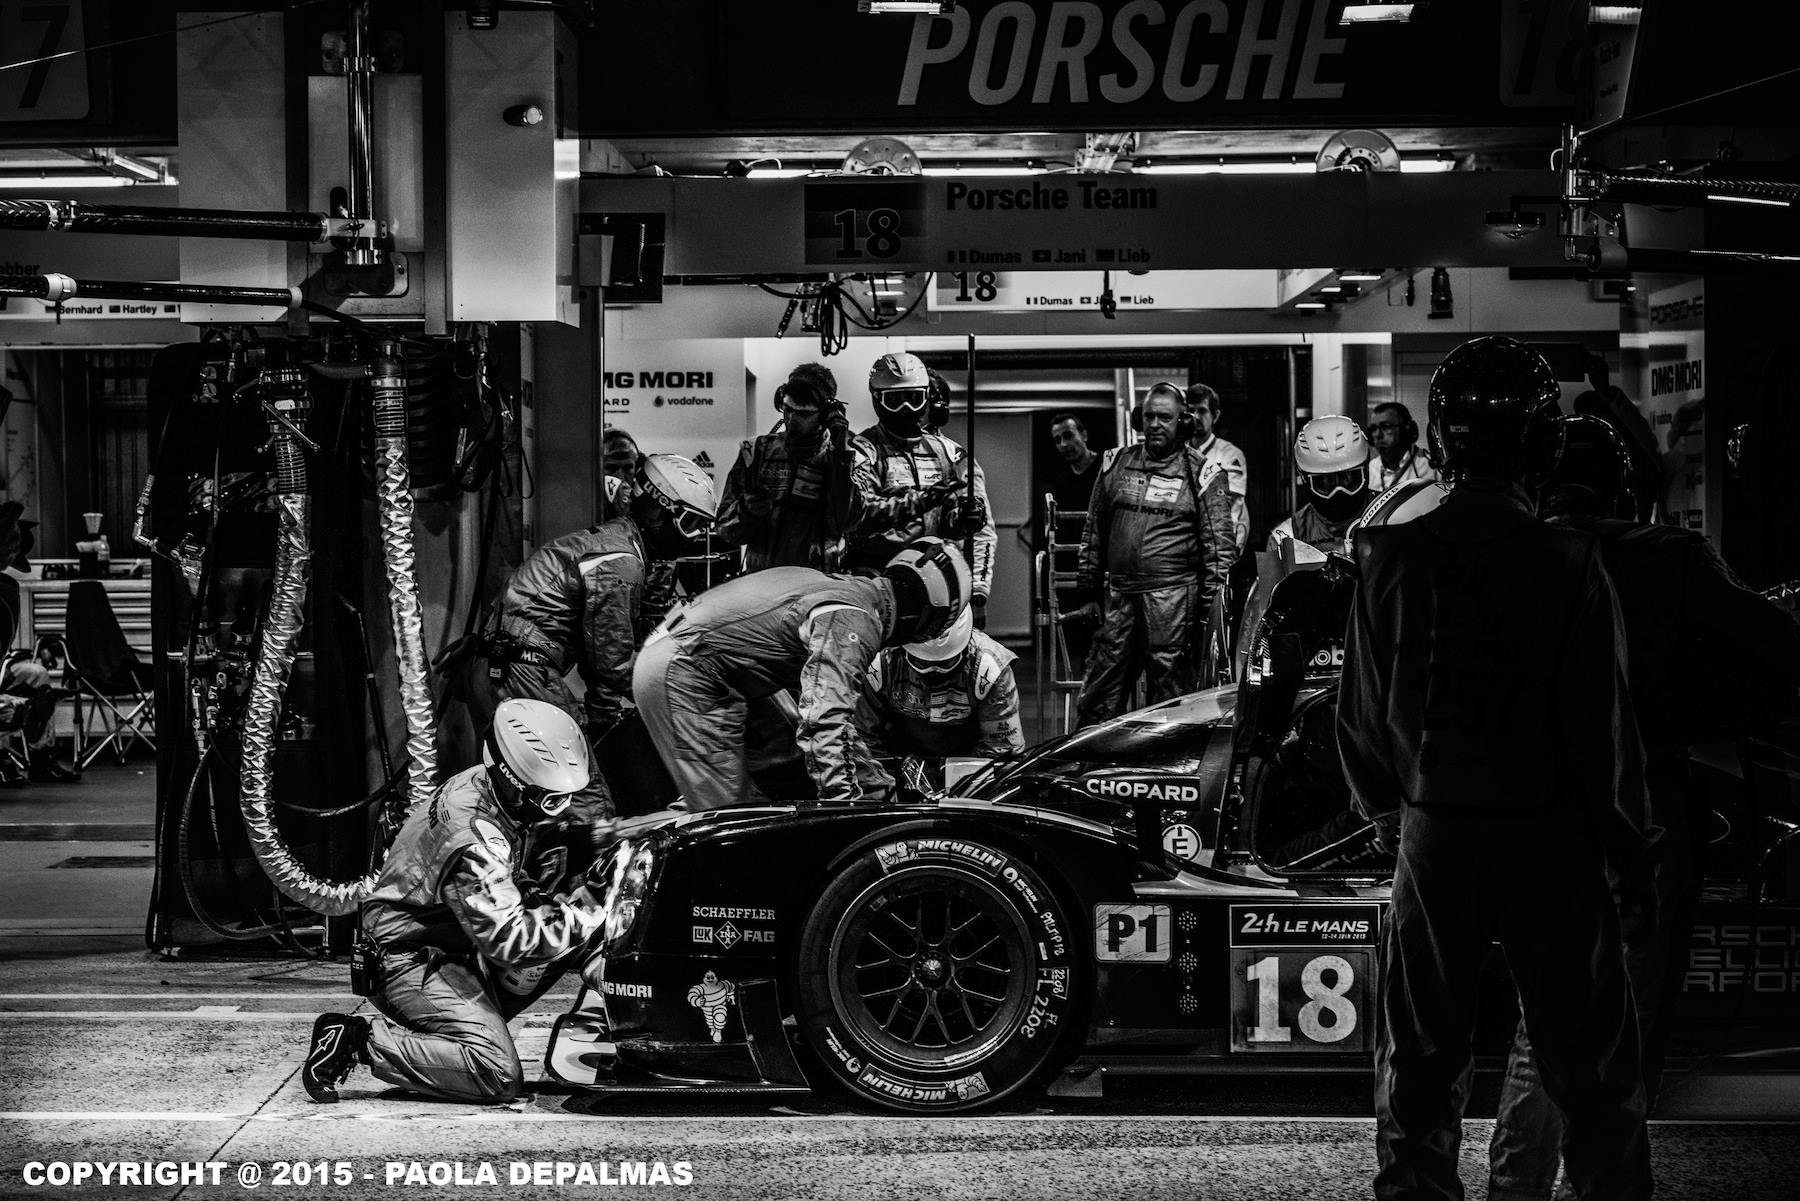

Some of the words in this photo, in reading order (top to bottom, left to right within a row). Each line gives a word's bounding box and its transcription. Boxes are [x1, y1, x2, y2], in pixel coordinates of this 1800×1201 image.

[897, 0, 1353, 106] PORSCHE
[946, 182, 1068, 210] Porsche
[1078, 181, 1157, 210] Team
[834, 207, 901, 260] 18
[969, 249, 1022, 264] Dumas
[1054, 249, 1086, 264] Jani
[1118, 248, 1150, 263] Lieb
[954, 271, 998, 302] 18
[122, 304, 157, 317] Hartley
[1040, 297, 1073, 305] Dumas
[1134, 296, 1154, 304] Lieb
[639, 372, 713, 388] MORI
[1652, 365, 1674, 396] DMG
[1675, 359, 1702, 392] MORI
[667, 396, 714, 406] vodafone
[643, 480, 681, 514] uvex
[1140, 505, 1174, 518] MORI
[498, 762, 527, 791] uvex
[1086, 778, 1199, 802] CHOPARD
[918, 841, 1004, 869] MICHELIN
[692, 906, 776, 920] SCHAEFFLER
[1240, 912, 1280, 934] 24h
[1284, 920, 1309, 933] LE
[1312, 920, 1369, 933] MANS
[743, 930, 775, 943] FAG
[1108, 913, 1158, 953] P1
[615, 983, 653, 999] MORI
[1682, 971, 1800, 992] RFO
[1246, 954, 1358, 1044] 18
[862, 1073, 947, 1101] MICHELIN
